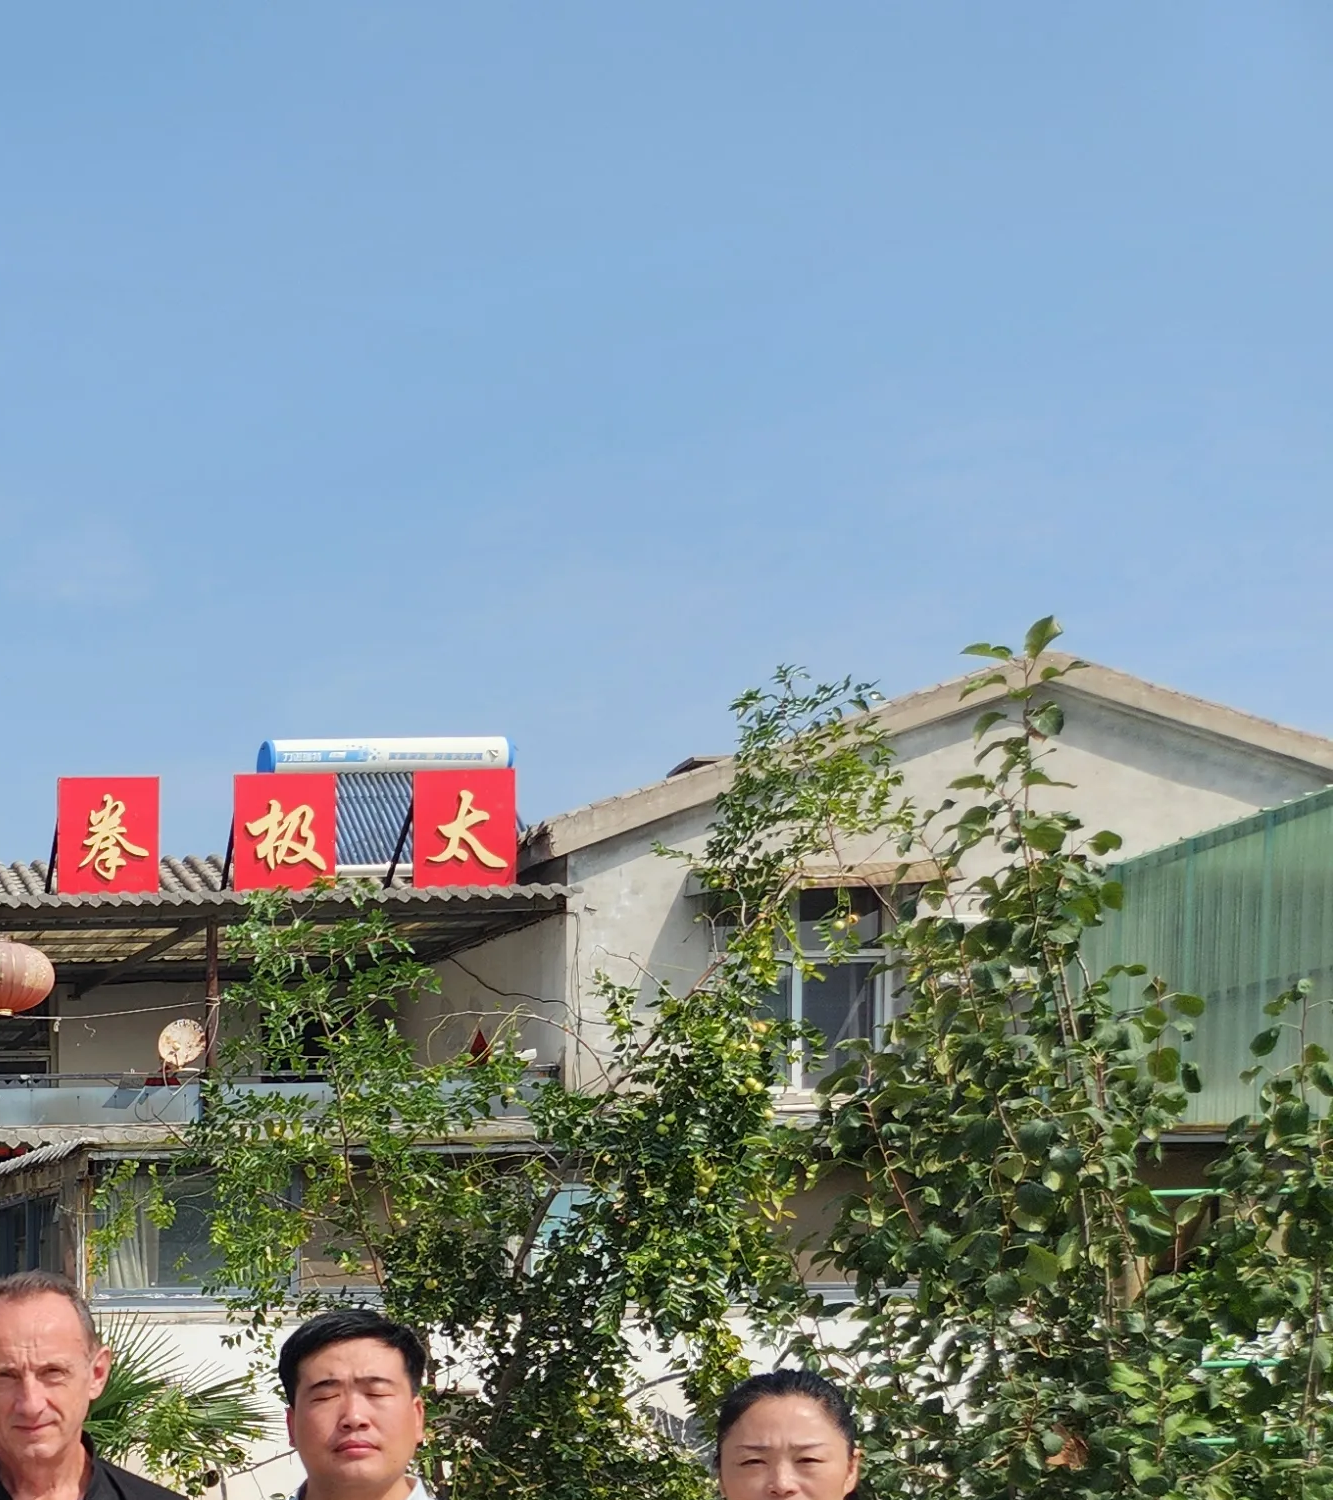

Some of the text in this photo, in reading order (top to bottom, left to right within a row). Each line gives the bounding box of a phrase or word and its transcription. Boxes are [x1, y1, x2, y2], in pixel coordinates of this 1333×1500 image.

[78, 793, 150, 880] 拳
[245, 799, 327, 871] 极
[427, 789, 509, 868] 太
